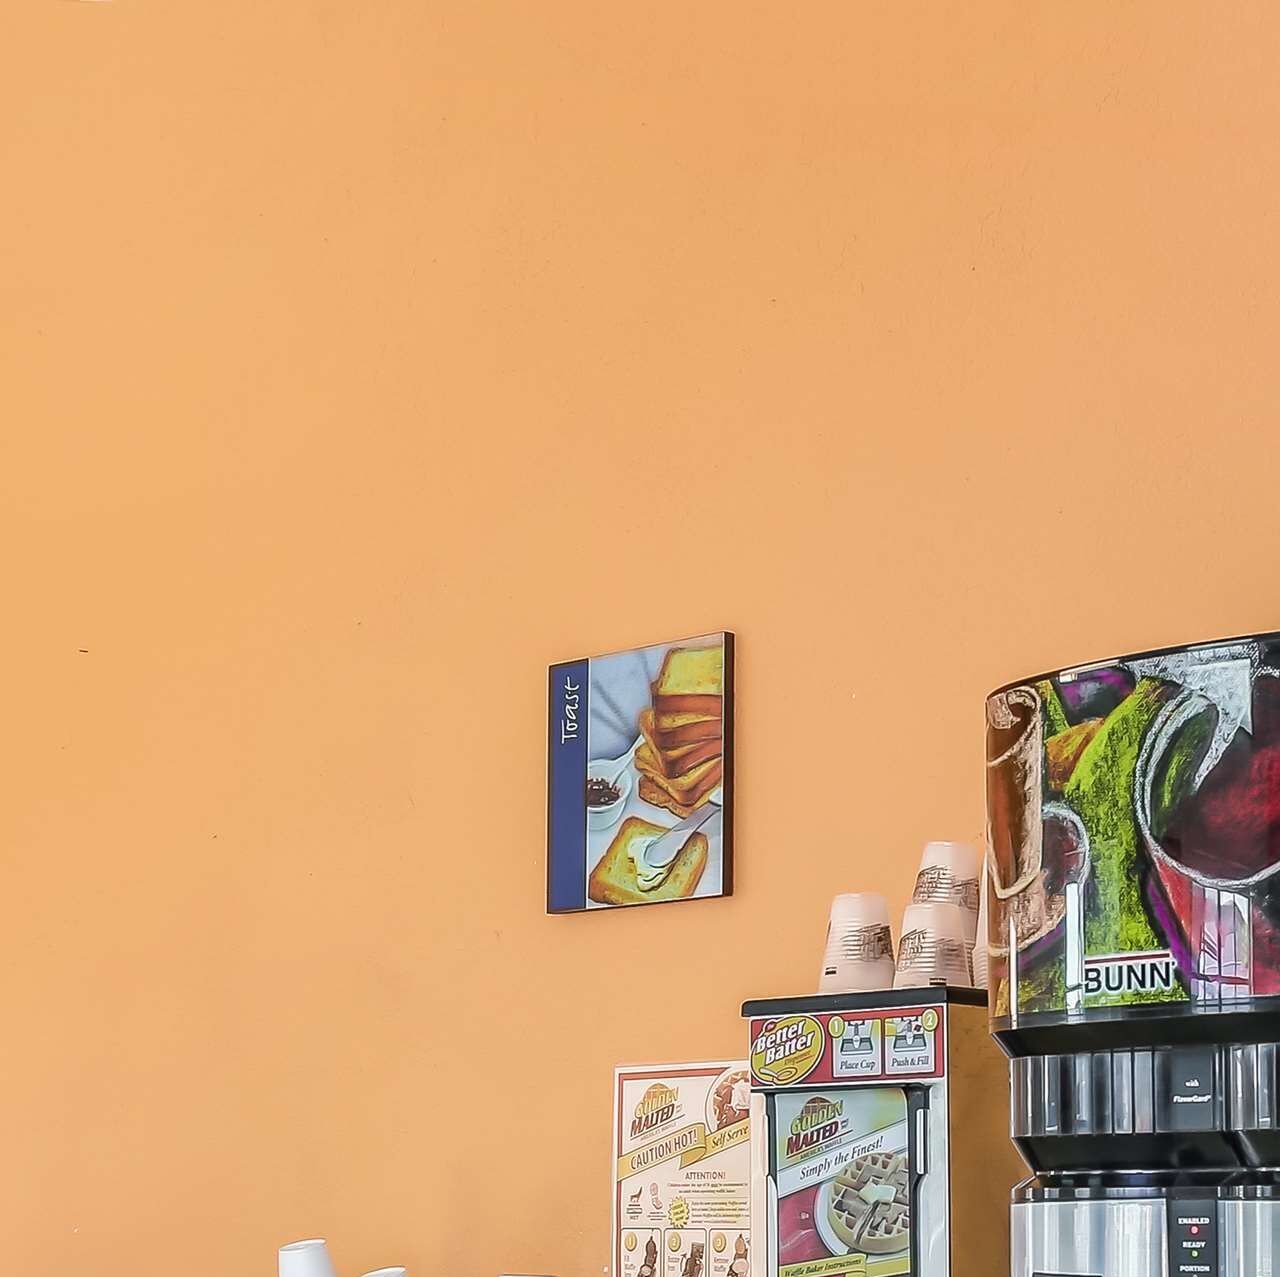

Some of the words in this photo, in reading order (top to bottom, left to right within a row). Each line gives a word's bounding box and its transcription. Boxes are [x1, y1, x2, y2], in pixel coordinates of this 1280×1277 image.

[561, 676, 579, 745] Toast
[1084, 961, 1171, 993] BUNN
[755, 1019, 807, 1055] Better
[764, 1030, 816, 1067] Batter
[840, 1061, 859, 1071] Place
[860, 1060, 876, 1071] Cup
[891, 1056, 910, 1067] Push
[630, 1103, 675, 1138] MALTED
[791, 1099, 844, 1135] GOLDEN
[630, 1145, 672, 1170] CAUTION
[674, 1129, 697, 1151] HOT!
[711, 1131, 727, 1149] Self
[727, 1125, 749, 1143] Serve
[786, 1120, 840, 1156] MALTED
[685, 1171, 726, 1180] ATTENTION!
[799, 1158, 834, 1180] Simply
[834, 1152, 850, 1167] the
[851, 1136, 884, 1159] Finest!
[1178, 1217, 1210, 1225] ENABLED
